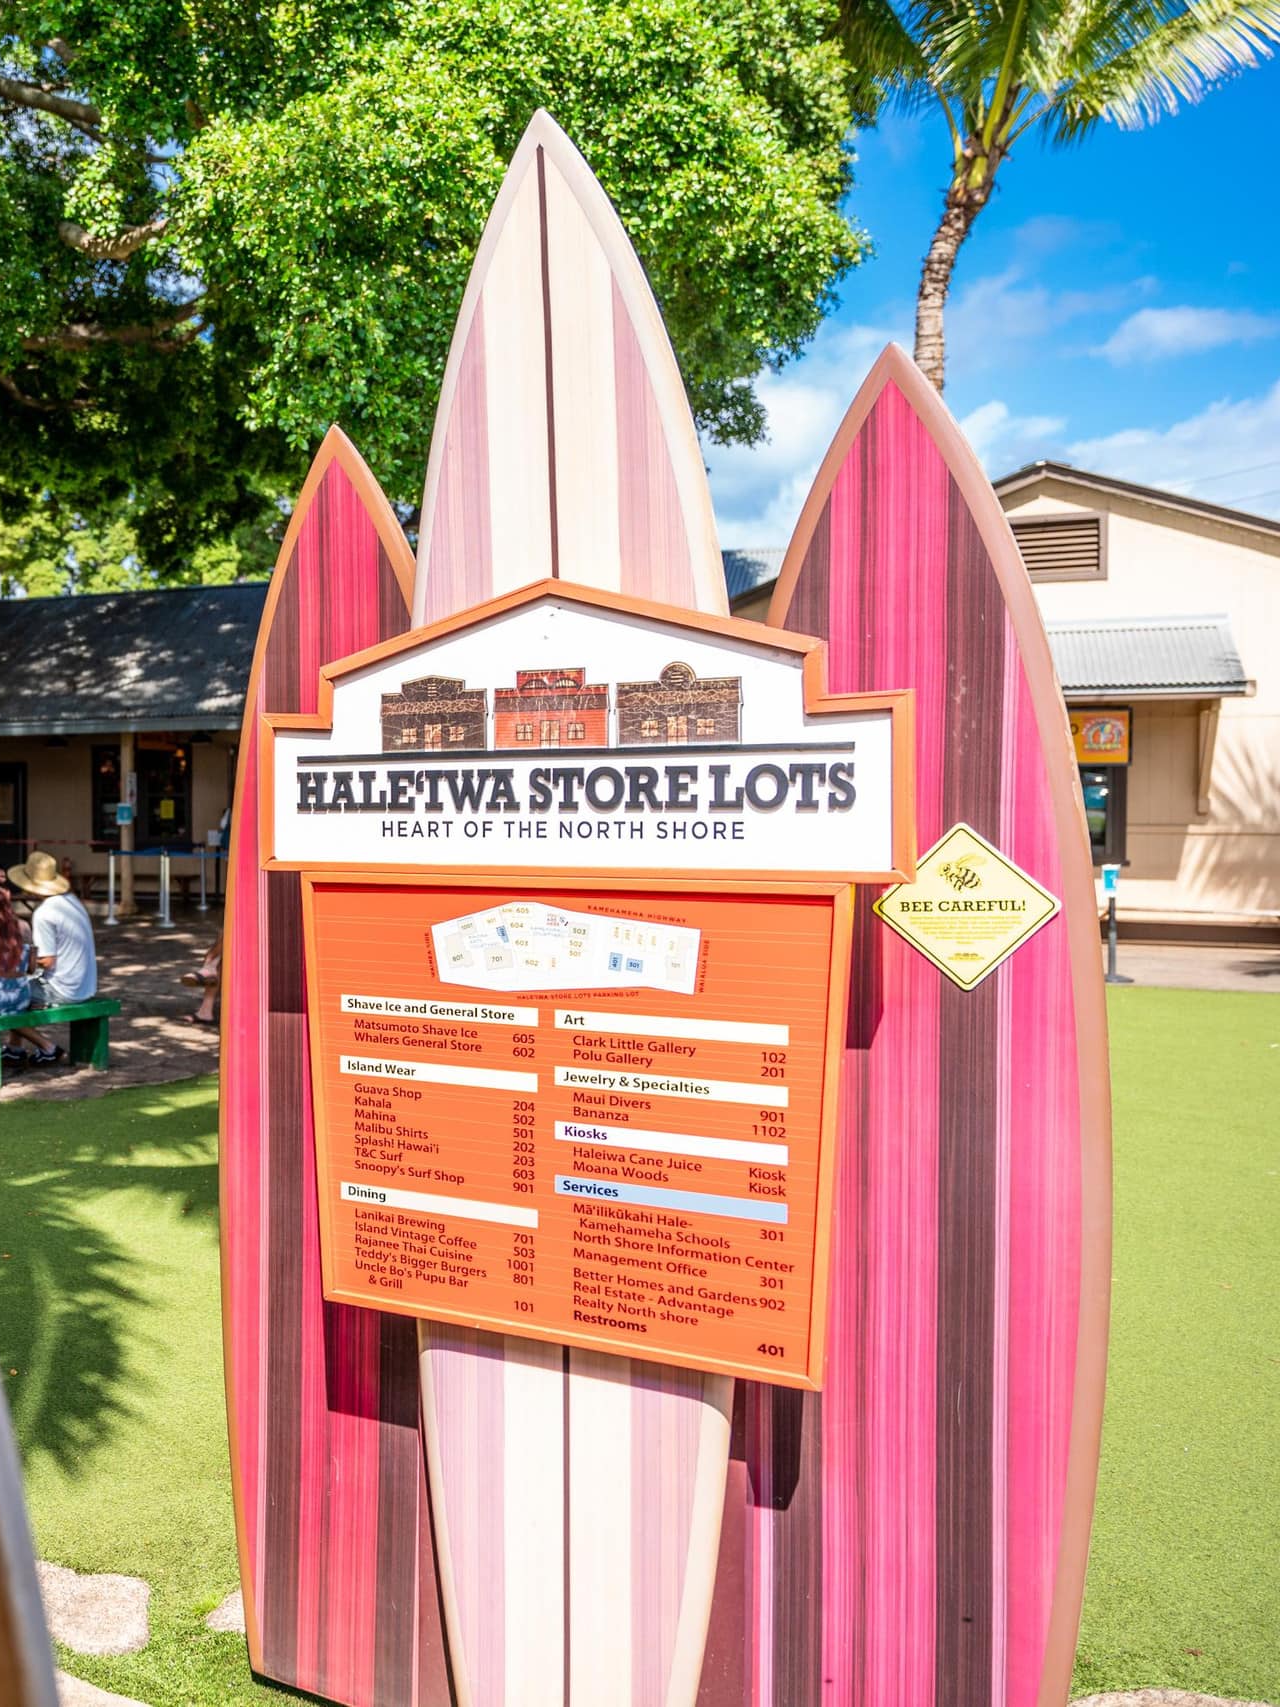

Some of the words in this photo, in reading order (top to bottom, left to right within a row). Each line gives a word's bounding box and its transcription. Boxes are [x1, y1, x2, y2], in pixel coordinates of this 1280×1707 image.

[529, 765, 699, 814] STORE
[708, 762, 857, 813] LOTS
[382, 820, 454, 838] HEART
[463, 820, 494, 838] OF
[504, 821, 548, 839] THE
[559, 820, 644, 839] NORTH
[656, 820, 745, 840] SHORE
[587, 905, 644, 918] KAMEHAMEHA
[648, 913, 687, 923] HIGHWAY
[899, 901, 934, 912] BEE
[938, 900, 1027, 912] CAREFUL!
[347, 998, 382, 1010] Shave
[385, 1001, 401, 1012] Ice
[403, 1003, 427, 1014] and
[429, 1004, 478, 1017] General
[480, 1008, 514, 1021] Store
[563, 1013, 584, 1026] Art
[354, 1018, 419, 1034] Matsumoto
[422, 1024, 458, 1037] Shave
[460, 1027, 478, 1039] Ice
[354, 1031, 399, 1045] Whalers
[401, 1035, 447, 1049] General
[450, 1039, 482, 1052] Store
[512, 1033, 535, 1044] 605
[572, 1035, 606, 1048] Clark
[609, 1037, 644, 1051] Little
[647, 1041, 696, 1057] Gallery
[512, 1046, 535, 1058] 602
[573, 1048, 602, 1061] Polu
[605, 1051, 653, 1068] Gallery
[761, 1051, 786, 1064] 102
[347, 1059, 382, 1073] Island
[384, 1063, 416, 1076] Wear
[760, 1065, 784, 1078] 201
[563, 1071, 616, 1088] Jewelry
[618, 1076, 629, 1087] &
[632, 1077, 710, 1095] Specialties
[354, 1082, 389, 1096] Guava
[392, 1086, 422, 1101] Shop
[354, 1095, 392, 1109] Kahala
[513, 1100, 535, 1112] 204
[573, 1091, 605, 1105] Maui
[609, 1095, 651, 1110] Divers
[354, 1108, 396, 1122] Mahina
[513, 1113, 535, 1126] 502
[573, 1105, 629, 1122] Bananza
[759, 1110, 784, 1123] 901
[354, 1121, 393, 1135] Malibu
[395, 1126, 428, 1139] Shirts
[512, 1127, 533, 1140] 501
[564, 1125, 607, 1140] Kiosks
[752, 1124, 786, 1138] 1102
[354, 1134, 394, 1148] Splash!
[512, 1140, 535, 1153] 202
[354, 1146, 377, 1159] T&C
[379, 1149, 403, 1162] Surf
[512, 1154, 535, 1167] 203
[573, 1146, 625, 1162] Haleiwa
[629, 1153, 663, 1167] Cane
[666, 1157, 702, 1172] Juice
[354, 1159, 405, 1176] Snoopy's
[407, 1166, 432, 1179] Surf
[433, 1170, 465, 1185] Shop
[512, 1168, 535, 1181] 603
[573, 1160, 618, 1176] Moana
[621, 1166, 669, 1182] Woods
[749, 1167, 786, 1182] Kiosk
[348, 1185, 386, 1203] Dining
[512, 1181, 533, 1194] 901
[562, 1180, 619, 1197] Services
[749, 1181, 786, 1197] Kiosk
[354, 1207, 394, 1223] Lanikai
[397, 1214, 445, 1234] Brewing
[656, 1214, 692, 1228] Hale-
[355, 1221, 388, 1235] Island
[390, 1226, 435, 1244] Vintage
[438, 1234, 477, 1250] Coffee
[513, 1232, 533, 1245] 701
[579, 1217, 672, 1241] Kamehameha
[676, 1231, 730, 1249] Schools
[759, 1228, 784, 1242] 301
[354, 1233, 399, 1250] Rajanee
[402, 1241, 426, 1254] Thai
[429, 1246, 473, 1262] Cuisine
[513, 1246, 535, 1259] 503
[573, 1230, 611, 1245] North
[614, 1236, 654, 1252] Shore
[657, 1242, 741, 1265] Information
[744, 1256, 794, 1273] Center
[354, 1246, 397, 1263] Teddy's
[400, 1253, 438, 1270] Bigger
[441, 1260, 487, 1278] Burgers
[507, 1258, 533, 1272] 1001
[573, 1247, 662, 1271] Management
[665, 1261, 707, 1278] Office
[355, 1259, 387, 1274] Uncle
[389, 1264, 412, 1278] Bo's
[415, 1269, 446, 1284] Pupu
[448, 1275, 468, 1288] Bar
[368, 1274, 377, 1285] &
[379, 1276, 403, 1289] Grill
[512, 1273, 533, 1286] 801
[573, 1267, 613, 1283] Better
[616, 1274, 664, 1291] Homes
[667, 1284, 694, 1296] and
[697, 1287, 757, 1307] Gardens
[759, 1276, 783, 1290] 301
[514, 1300, 533, 1313] 101
[573, 1280, 601, 1295] Real
[604, 1286, 645, 1302] Estate
[657, 1295, 734, 1318] Advantage
[759, 1297, 785, 1311] 902
[573, 1294, 614, 1313] Realty
[617, 1302, 656, 1319] North
[659, 1310, 698, 1326] shore
[573, 1309, 647, 1333] Restrooms
[757, 1343, 784, 1358] 401
